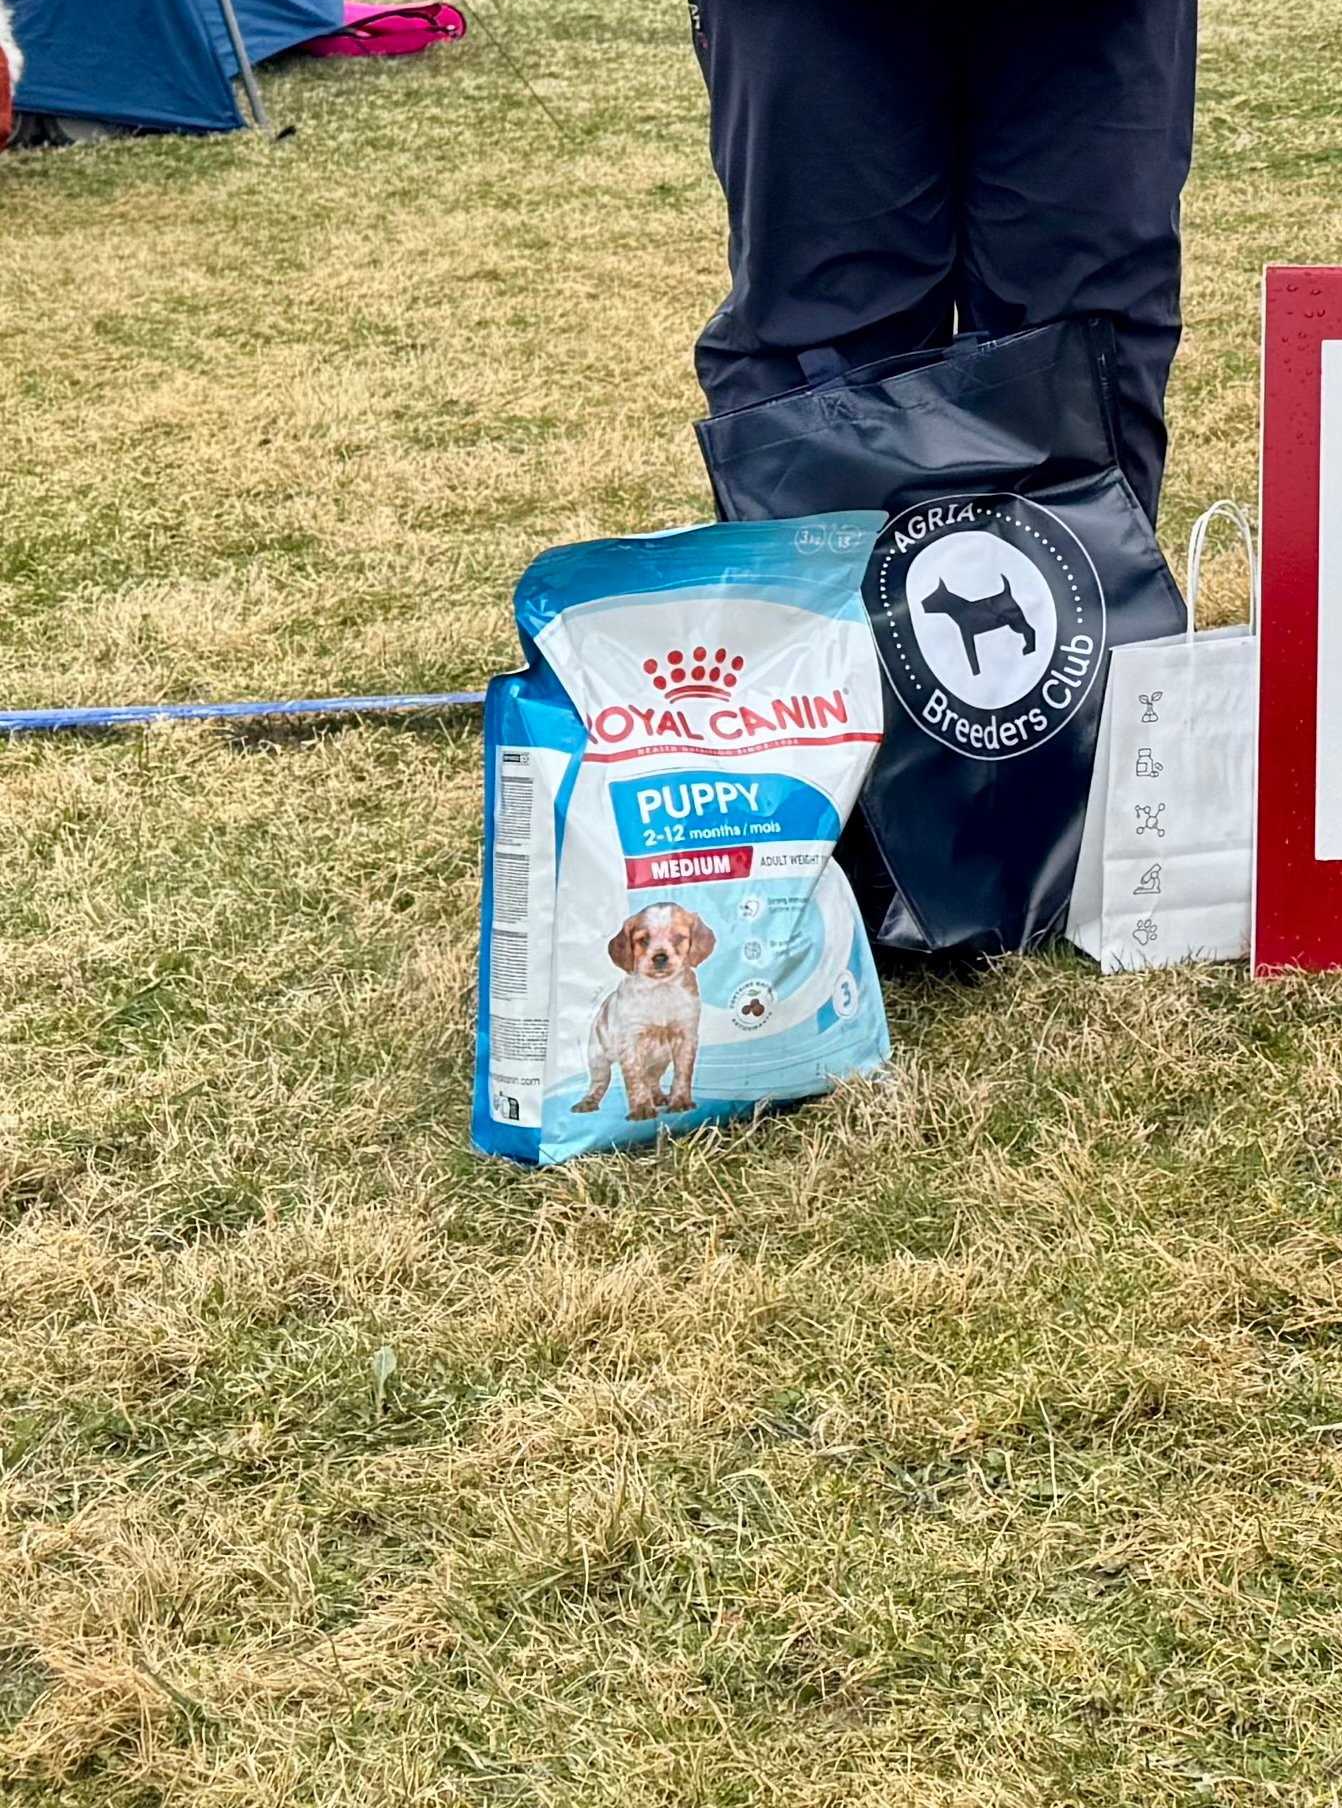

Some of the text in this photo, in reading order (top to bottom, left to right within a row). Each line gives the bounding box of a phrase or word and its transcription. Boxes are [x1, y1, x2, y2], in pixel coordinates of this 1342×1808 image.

[894, 503, 976, 553] AGRIA
[921, 635, 1094, 750] Breeders Club
[709, 689, 848, 740] CANIN
[636, 782, 760, 824] PUPPY
[643, 824, 686, 847] 2-12
[689, 821, 741, 840] months
[651, 854, 731, 880] MEDIUM
[760, 855, 787, 866] ADULT
[790, 854, 820, 865] WEIGHT
